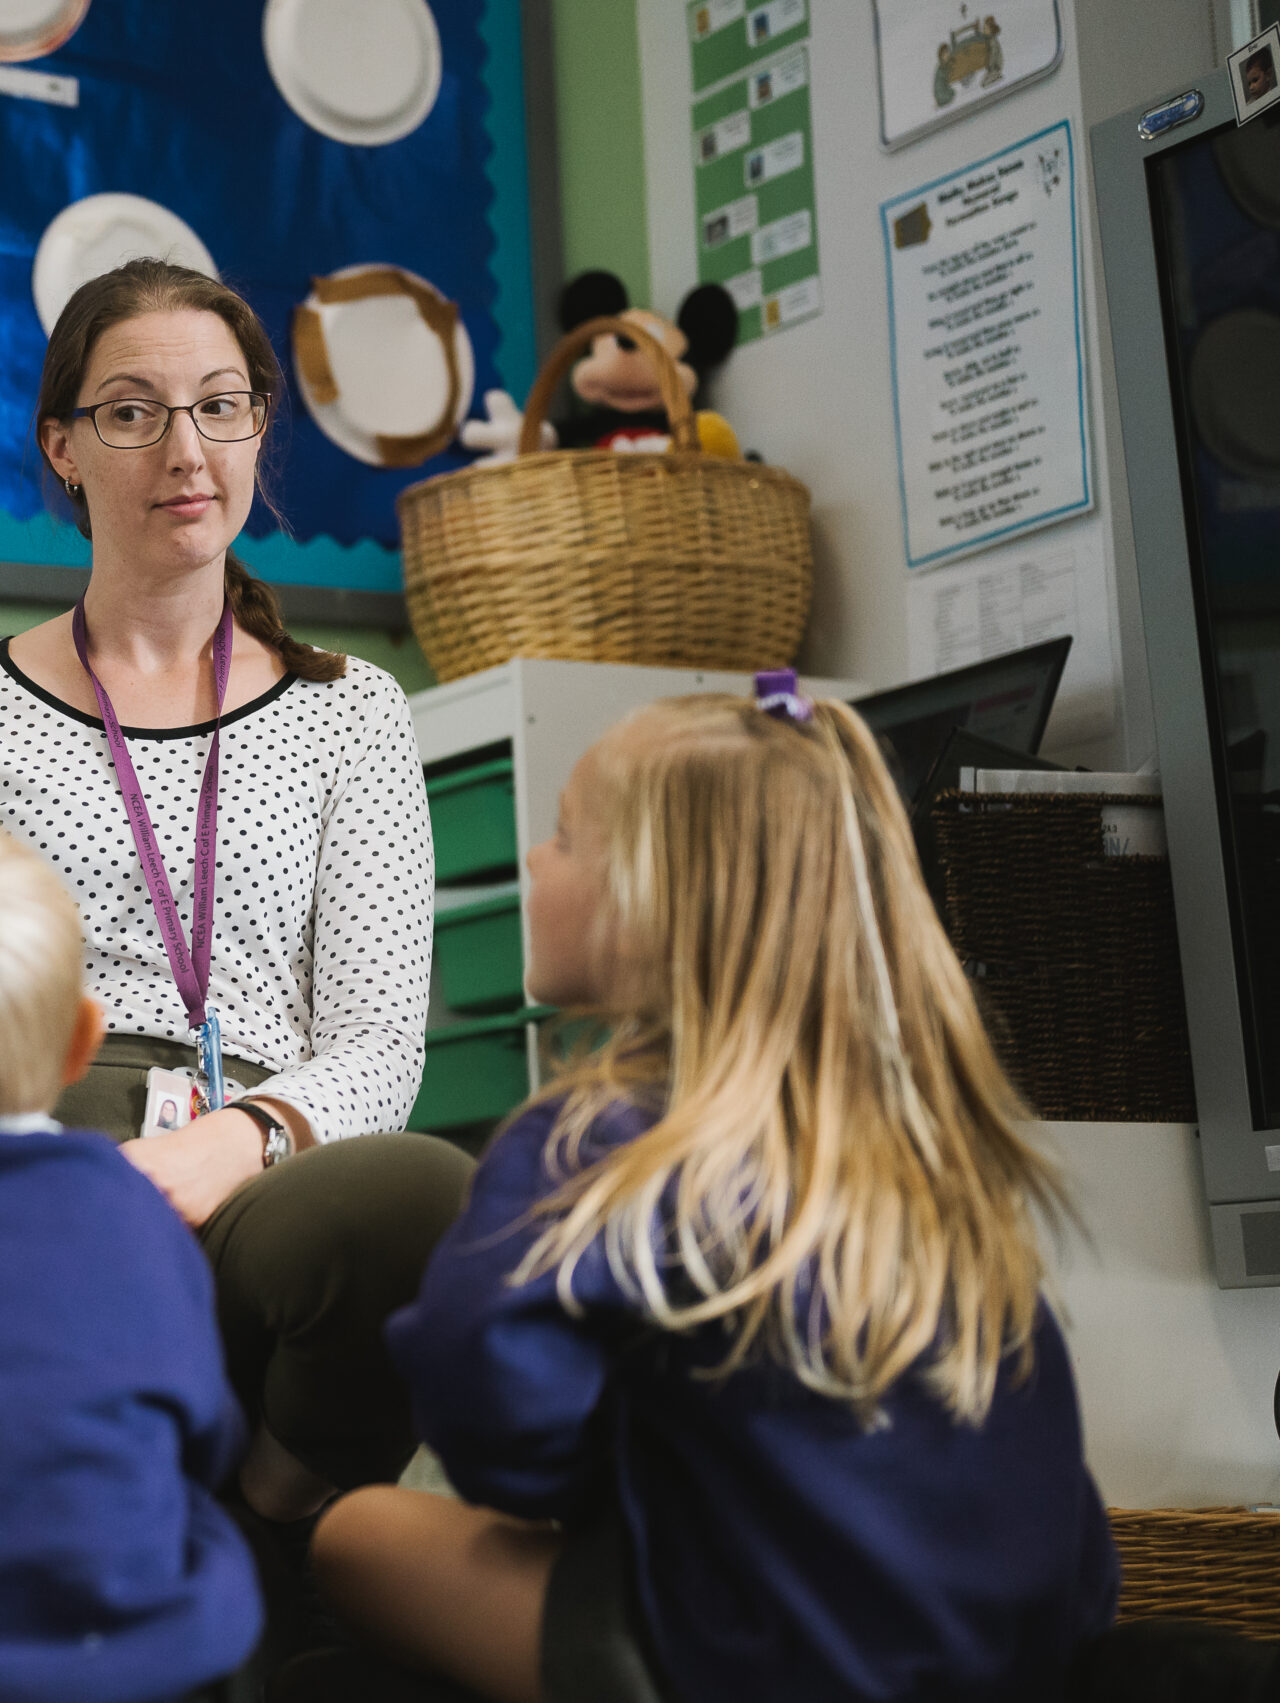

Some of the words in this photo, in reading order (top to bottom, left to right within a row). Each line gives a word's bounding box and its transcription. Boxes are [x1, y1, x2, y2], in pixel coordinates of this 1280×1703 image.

[108, 720, 123, 748] School
[202, 795, 212, 830] Primary
[201, 838, 209, 848] of
[130, 793, 143, 818] NCEA
[137, 819, 152, 851] William
[147, 852, 161, 878] Leech
[157, 888, 169, 899] of
[163, 907, 178, 941] Primary
[173, 942, 189, 973] School
[200, 861, 209, 885] Leech
[199, 887, 207, 921] William
[196, 923, 206, 949] NCEA
